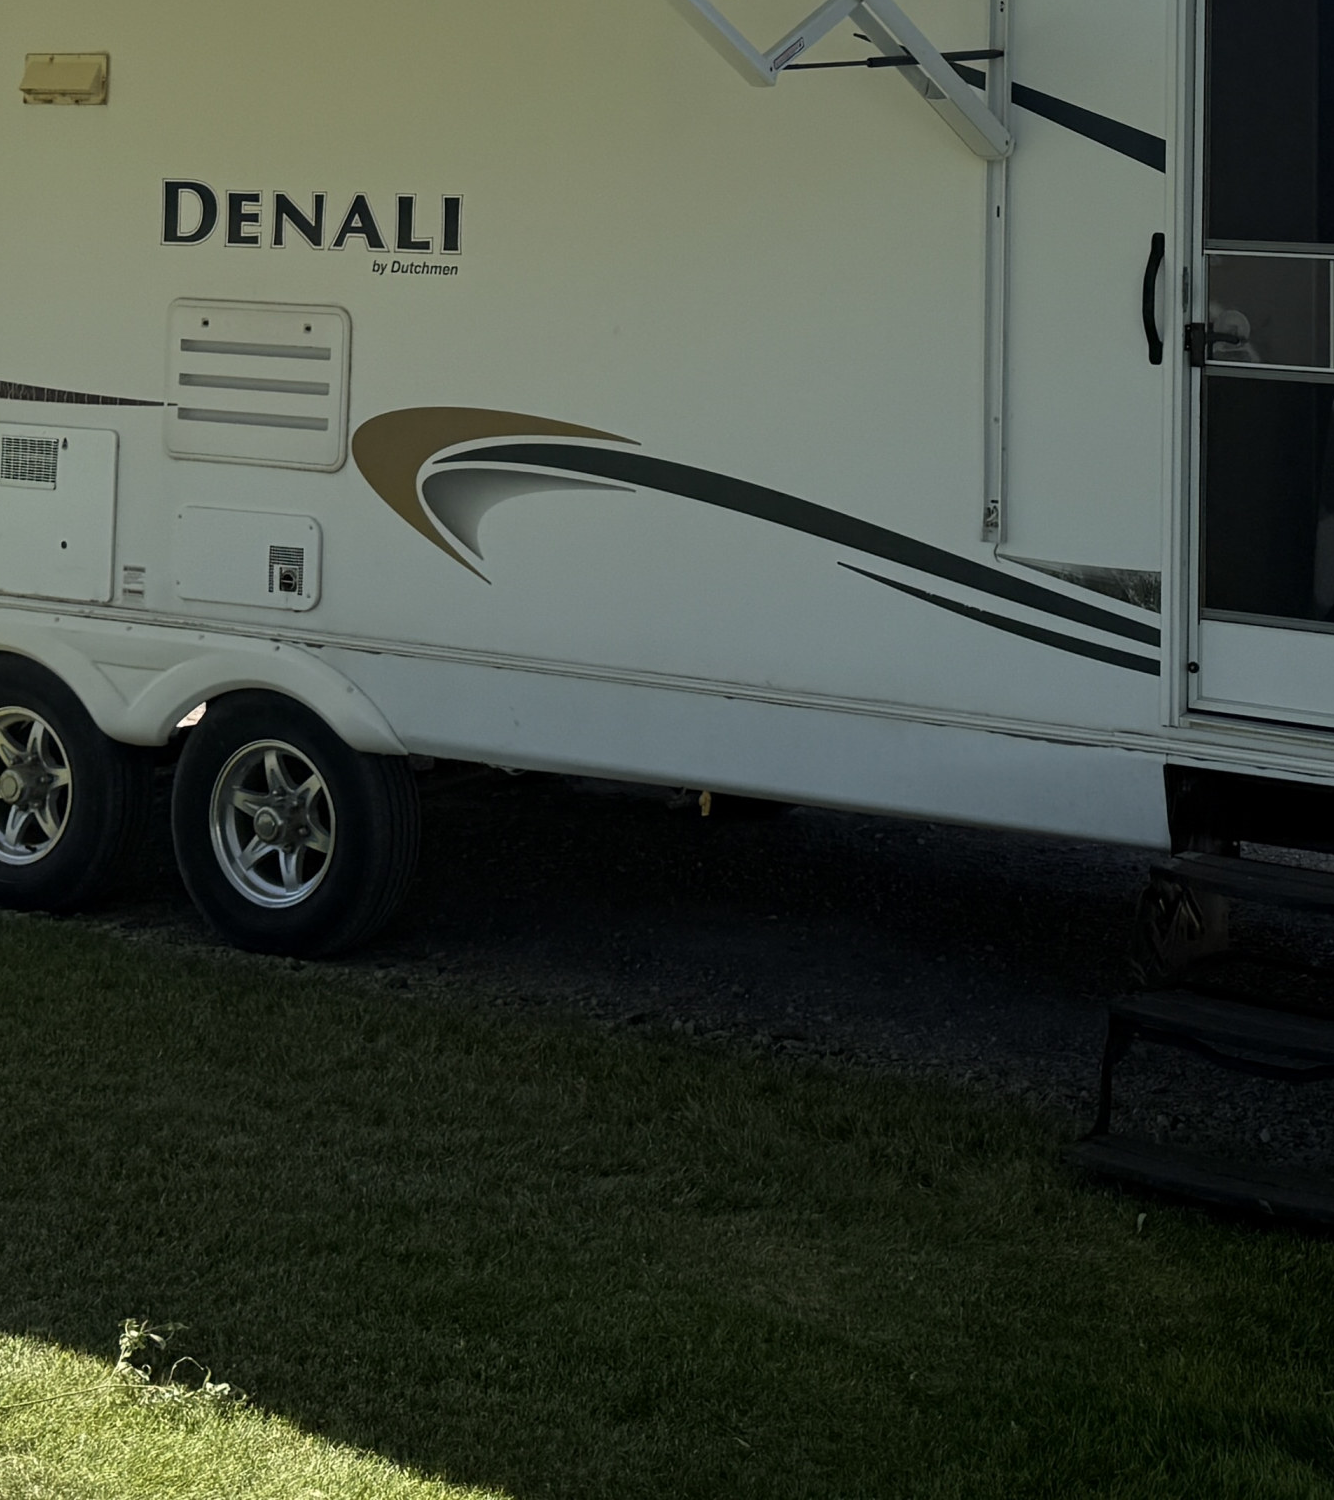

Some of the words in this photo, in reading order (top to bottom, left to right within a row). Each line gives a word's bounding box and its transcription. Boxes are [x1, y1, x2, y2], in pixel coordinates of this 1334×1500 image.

[161, 178, 464, 255] DENALI
[372, 260, 388, 275] by
[391, 260, 458, 275] Dutchmen
